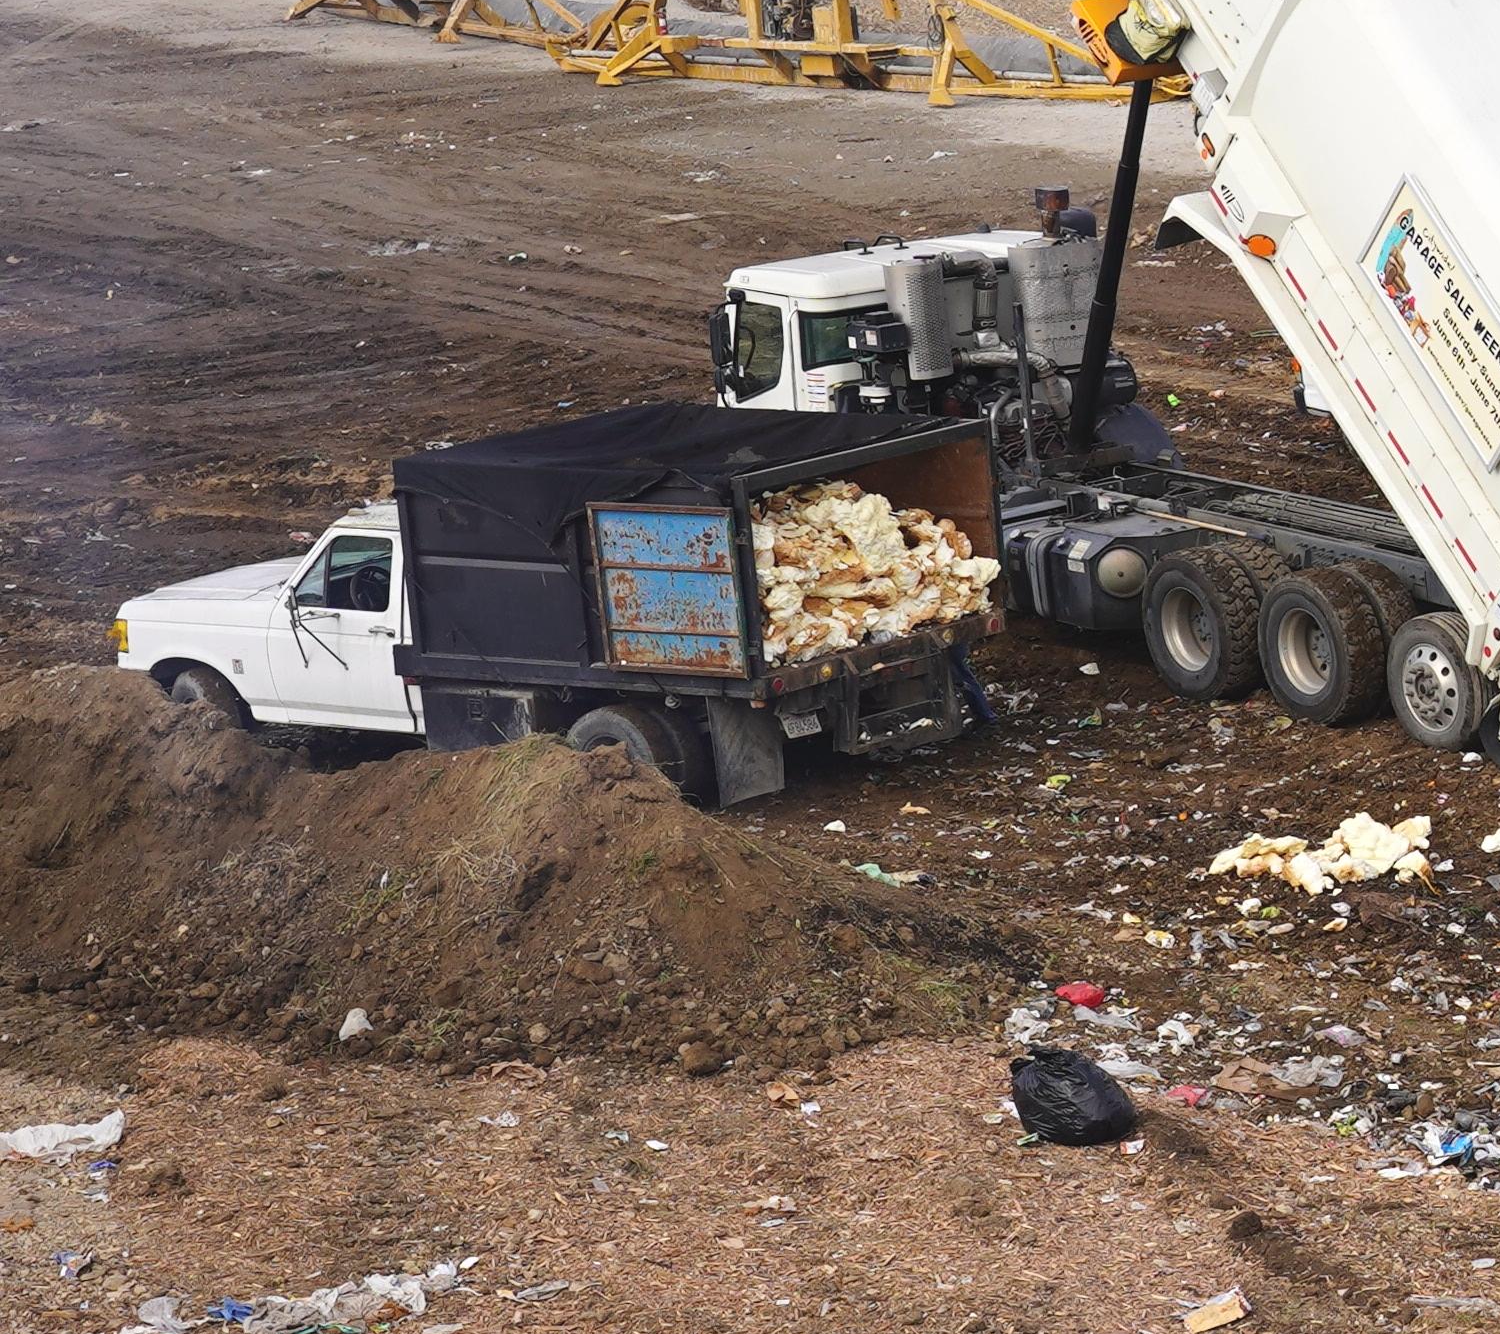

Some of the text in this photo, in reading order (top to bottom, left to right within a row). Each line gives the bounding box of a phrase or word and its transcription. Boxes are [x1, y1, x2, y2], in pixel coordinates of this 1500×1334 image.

[1399, 216, 1445, 280] GARAGE
[1444, 278, 1475, 321] SALE
[1432, 318, 1453, 348] June
[1470, 378, 1491, 408] June
